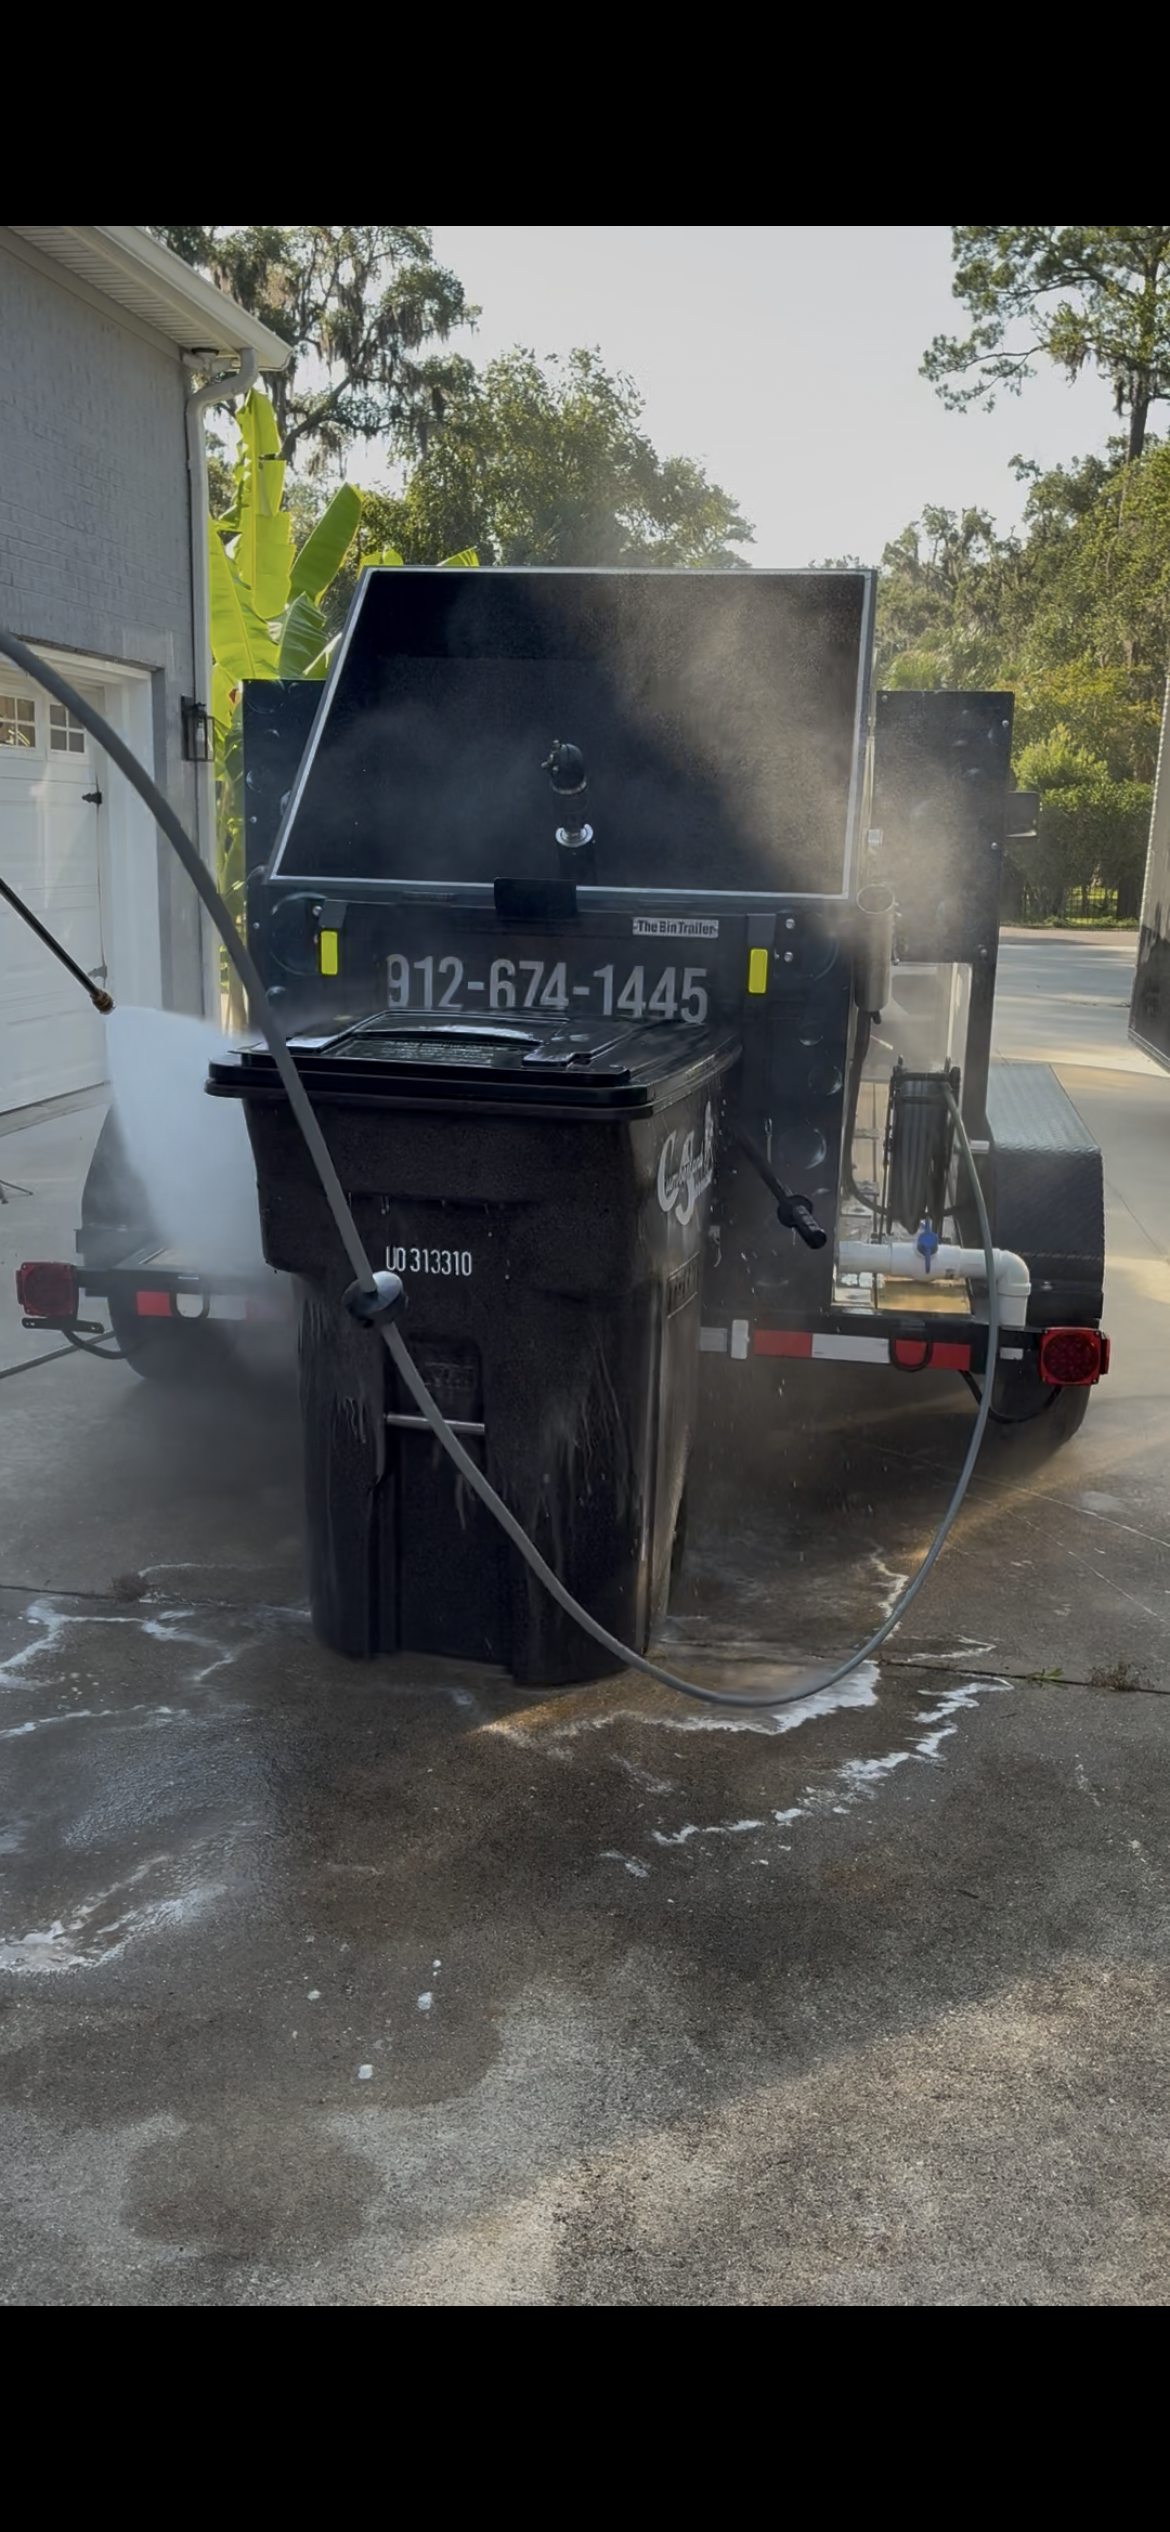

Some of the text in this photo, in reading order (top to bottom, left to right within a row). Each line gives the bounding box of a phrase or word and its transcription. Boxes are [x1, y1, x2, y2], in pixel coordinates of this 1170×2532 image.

[637, 919, 715, 935] The Bin Trailer
[386, 953, 709, 1024] 912-674-1445
[410, 1247, 473, 1277] 313310
